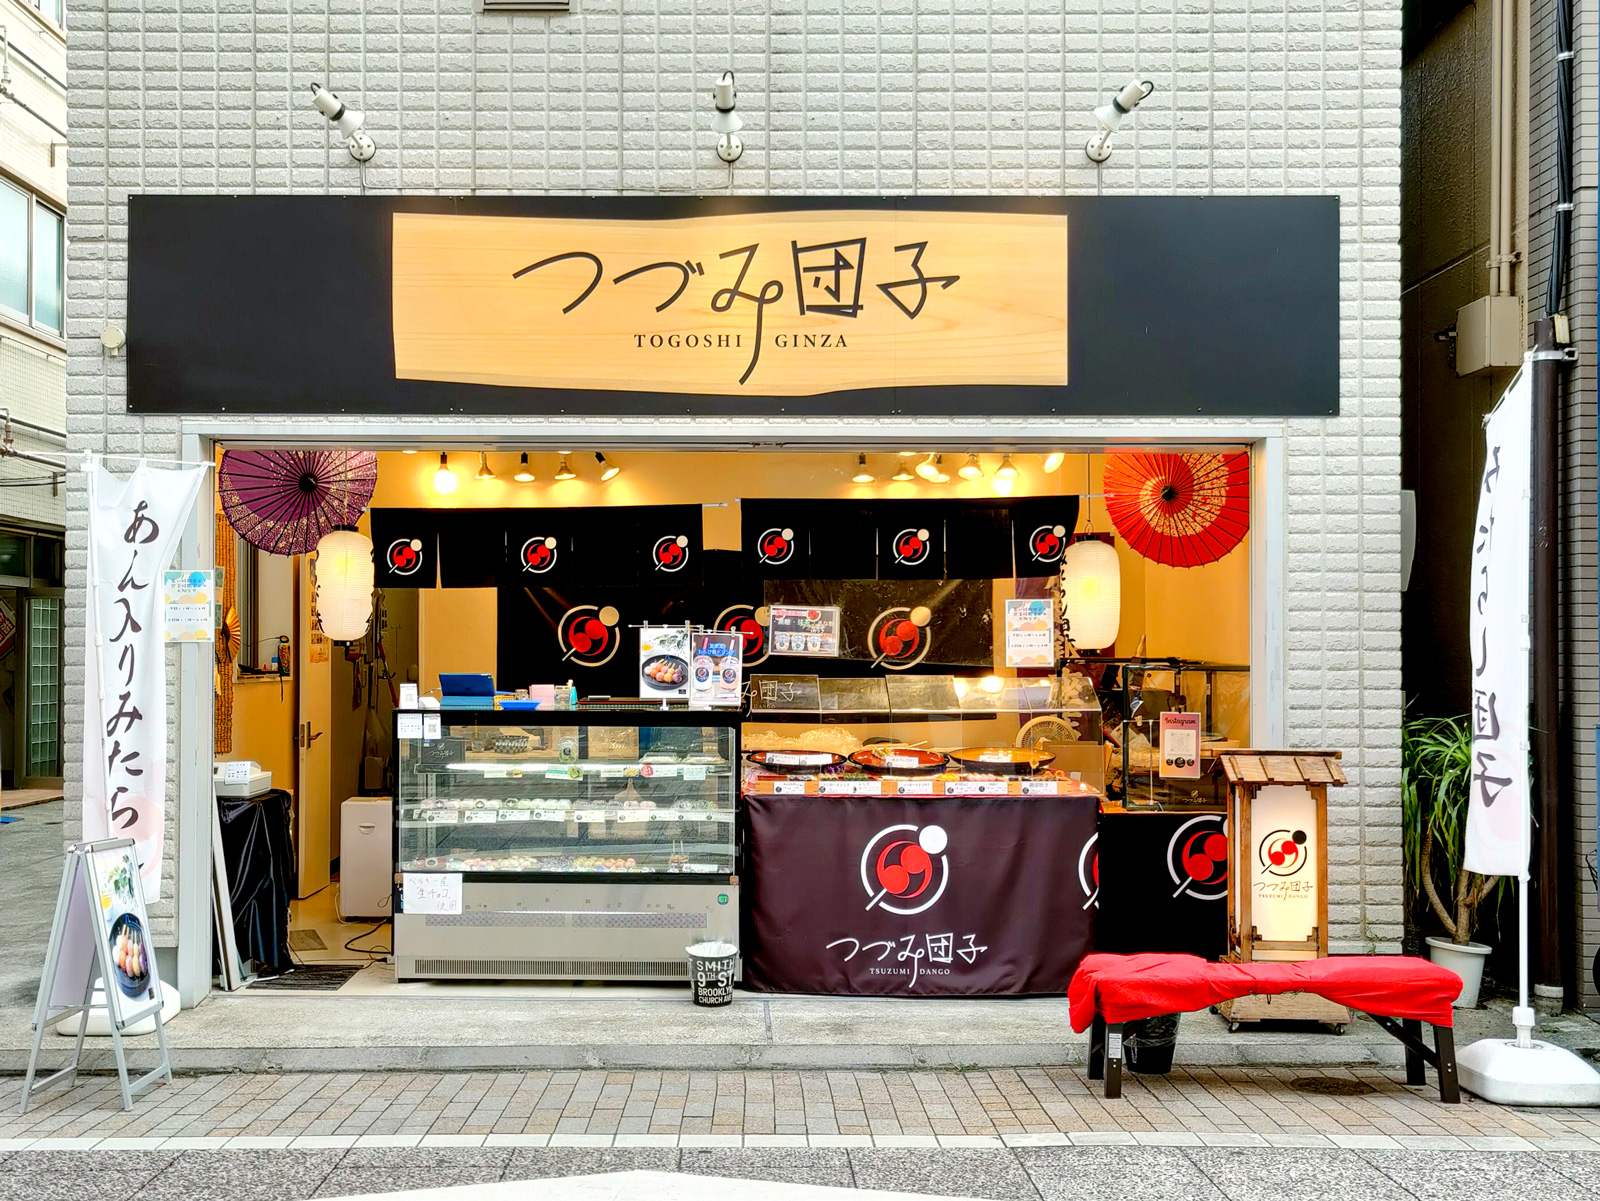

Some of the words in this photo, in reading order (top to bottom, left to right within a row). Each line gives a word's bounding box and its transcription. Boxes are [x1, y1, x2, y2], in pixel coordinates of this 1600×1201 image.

[513, 237, 960, 385] つづみ団子
[634, 333, 743, 349] TOGOSHI
[775, 333, 848, 349] GINZA
[107, 500, 159, 870] あん入りみたら
[1165, 717, 1197, 726] Instagram
[696, 958, 735, 972] SMITH
[826, 932, 988, 989] つづみ団子
[717, 969, 734, 988] ST
[869, 967, 910, 975] TSUZUMI
[919, 967, 950, 975] DANGO
[698, 995, 723, 1005] CHURCH
